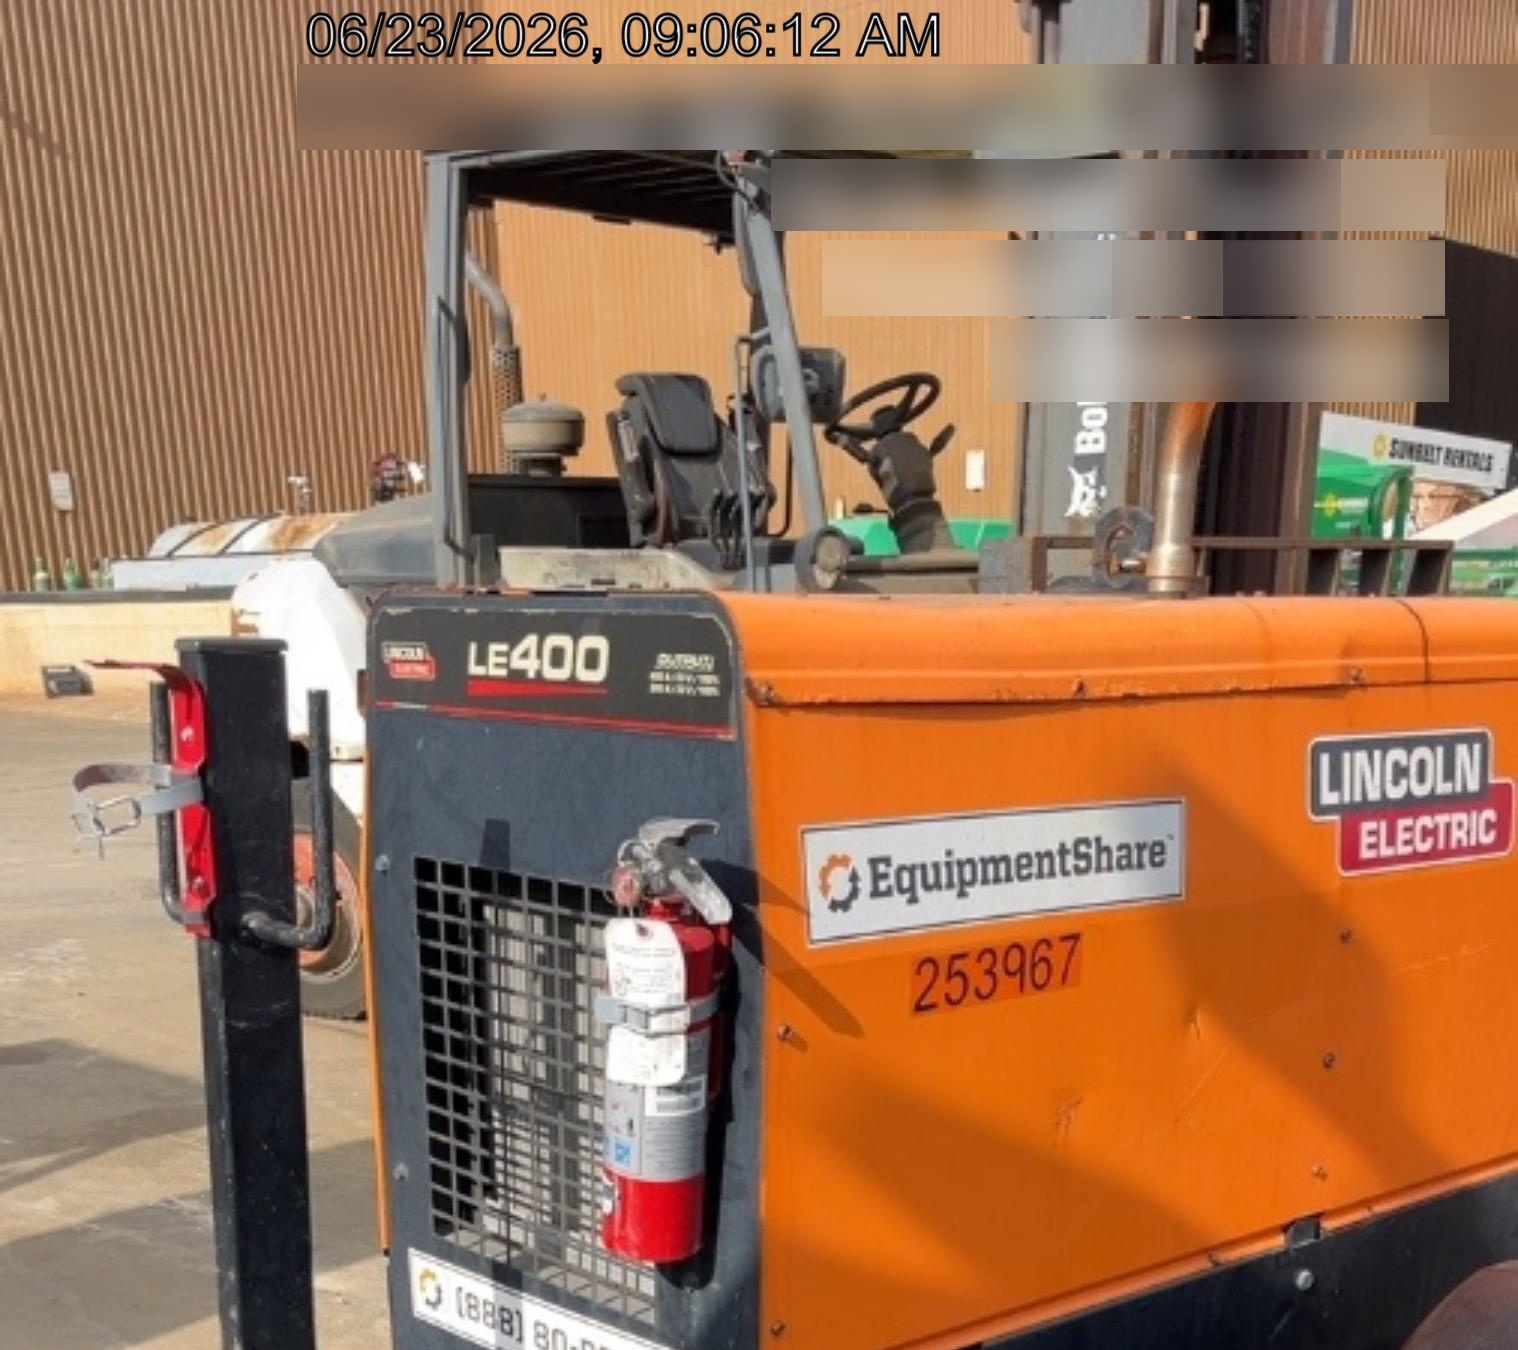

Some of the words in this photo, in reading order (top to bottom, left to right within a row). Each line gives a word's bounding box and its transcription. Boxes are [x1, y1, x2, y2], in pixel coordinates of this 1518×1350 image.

[1443, 446, 1494, 473] RENTALS
[467, 632, 610, 682] LE400
[1319, 743, 1481, 805] LINCOLN
[1359, 808, 1498, 860] ELECTRIC
[867, 834, 1168, 903] EquipmentShare
[912, 932, 1081, 1013] 253967
